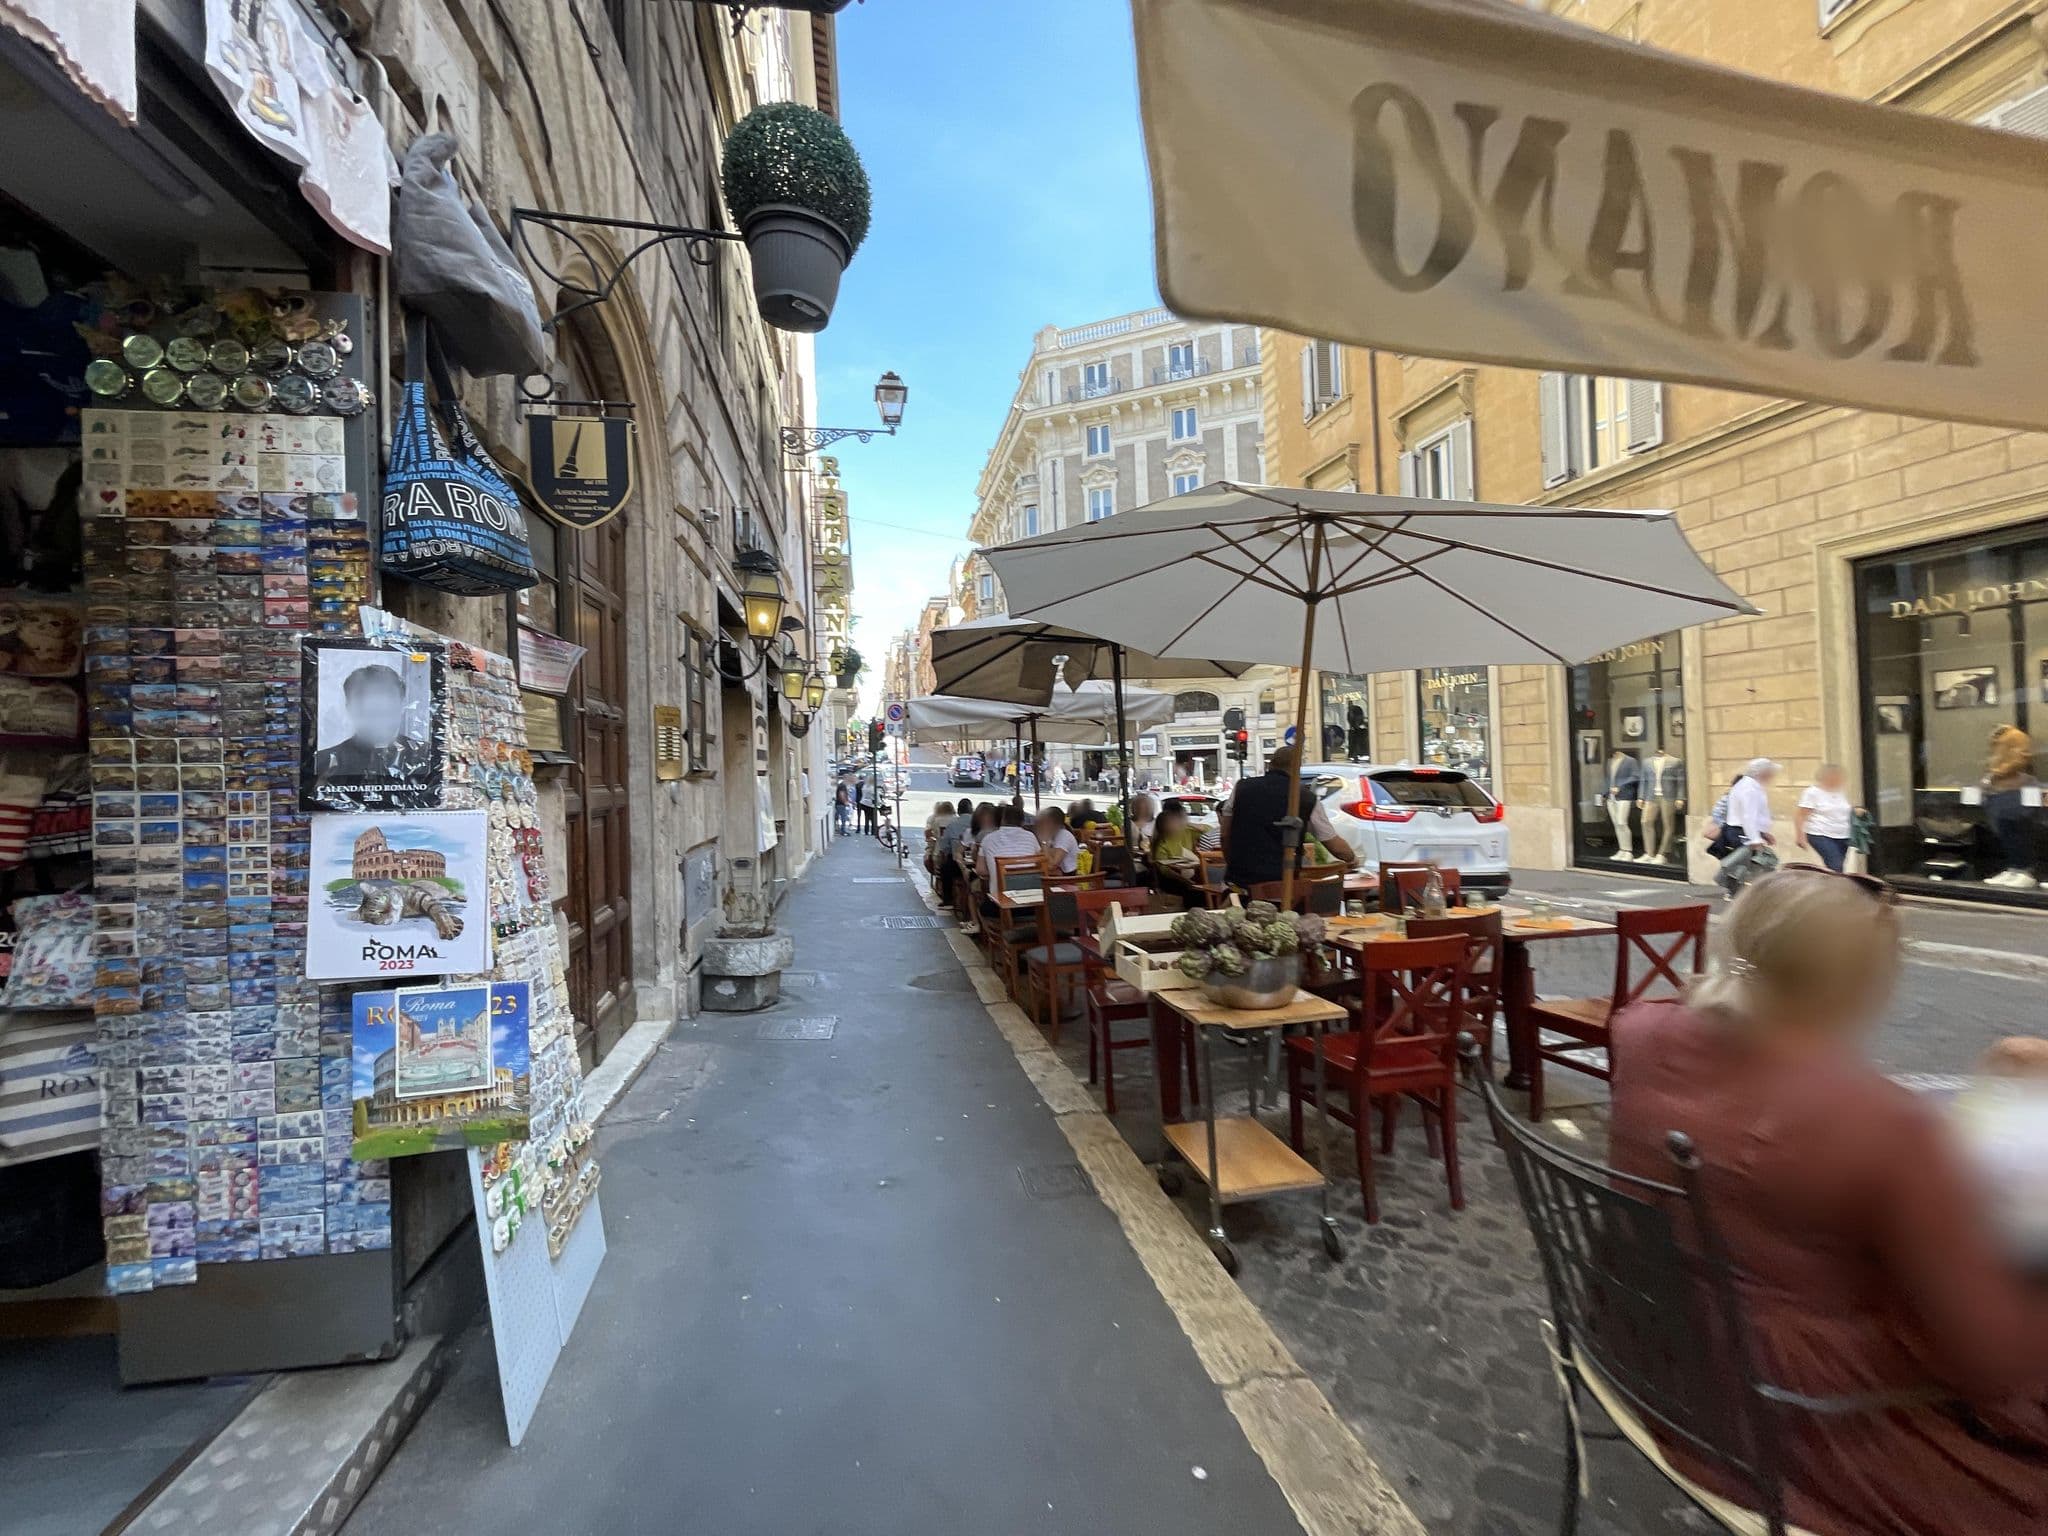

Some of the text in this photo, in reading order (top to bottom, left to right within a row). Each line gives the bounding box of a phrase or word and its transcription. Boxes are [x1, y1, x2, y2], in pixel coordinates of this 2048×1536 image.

[418, 460, 451, 472] ROMA
[435, 528, 469, 542] ROMA
[820, 456, 845, 675] RISTORANTE
[1890, 578, 2048, 618] DAN JOHN
[1619, 641, 1664, 662] JOHN
[1427, 673, 1478, 690] DAN JOHN
[317, 783, 428, 793] CALENDARIO ROMANO
[362, 944, 431, 961] ROMA
[379, 960, 415, 970] 2023
[405, 996, 456, 1012] Roma
